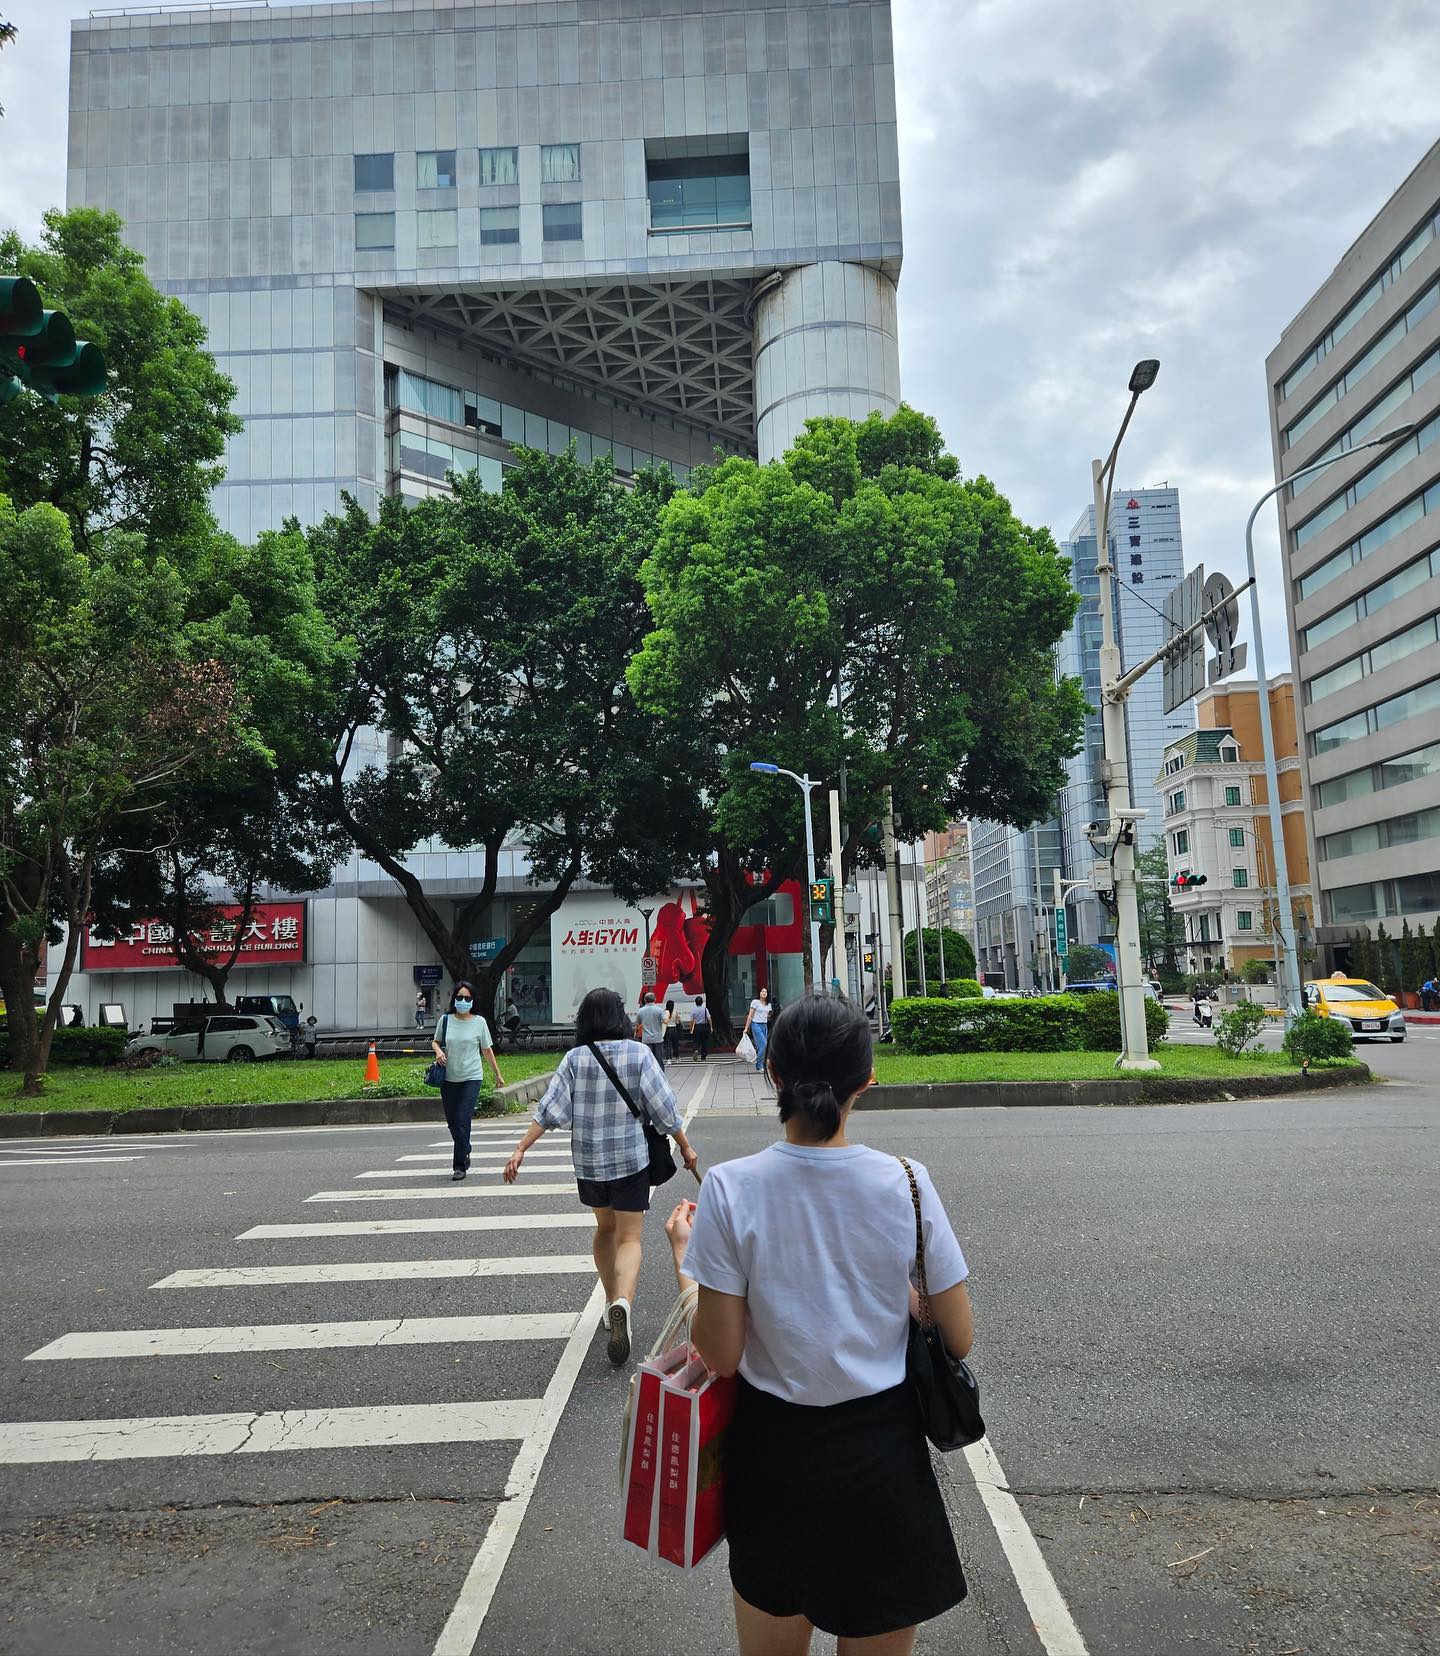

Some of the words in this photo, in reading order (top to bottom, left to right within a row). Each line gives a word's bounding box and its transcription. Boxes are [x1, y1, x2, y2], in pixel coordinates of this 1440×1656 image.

[812, 884, 827, 900] 32
[141, 947, 174, 955] CHINA
[254, 942, 299, 951] BUILDING
